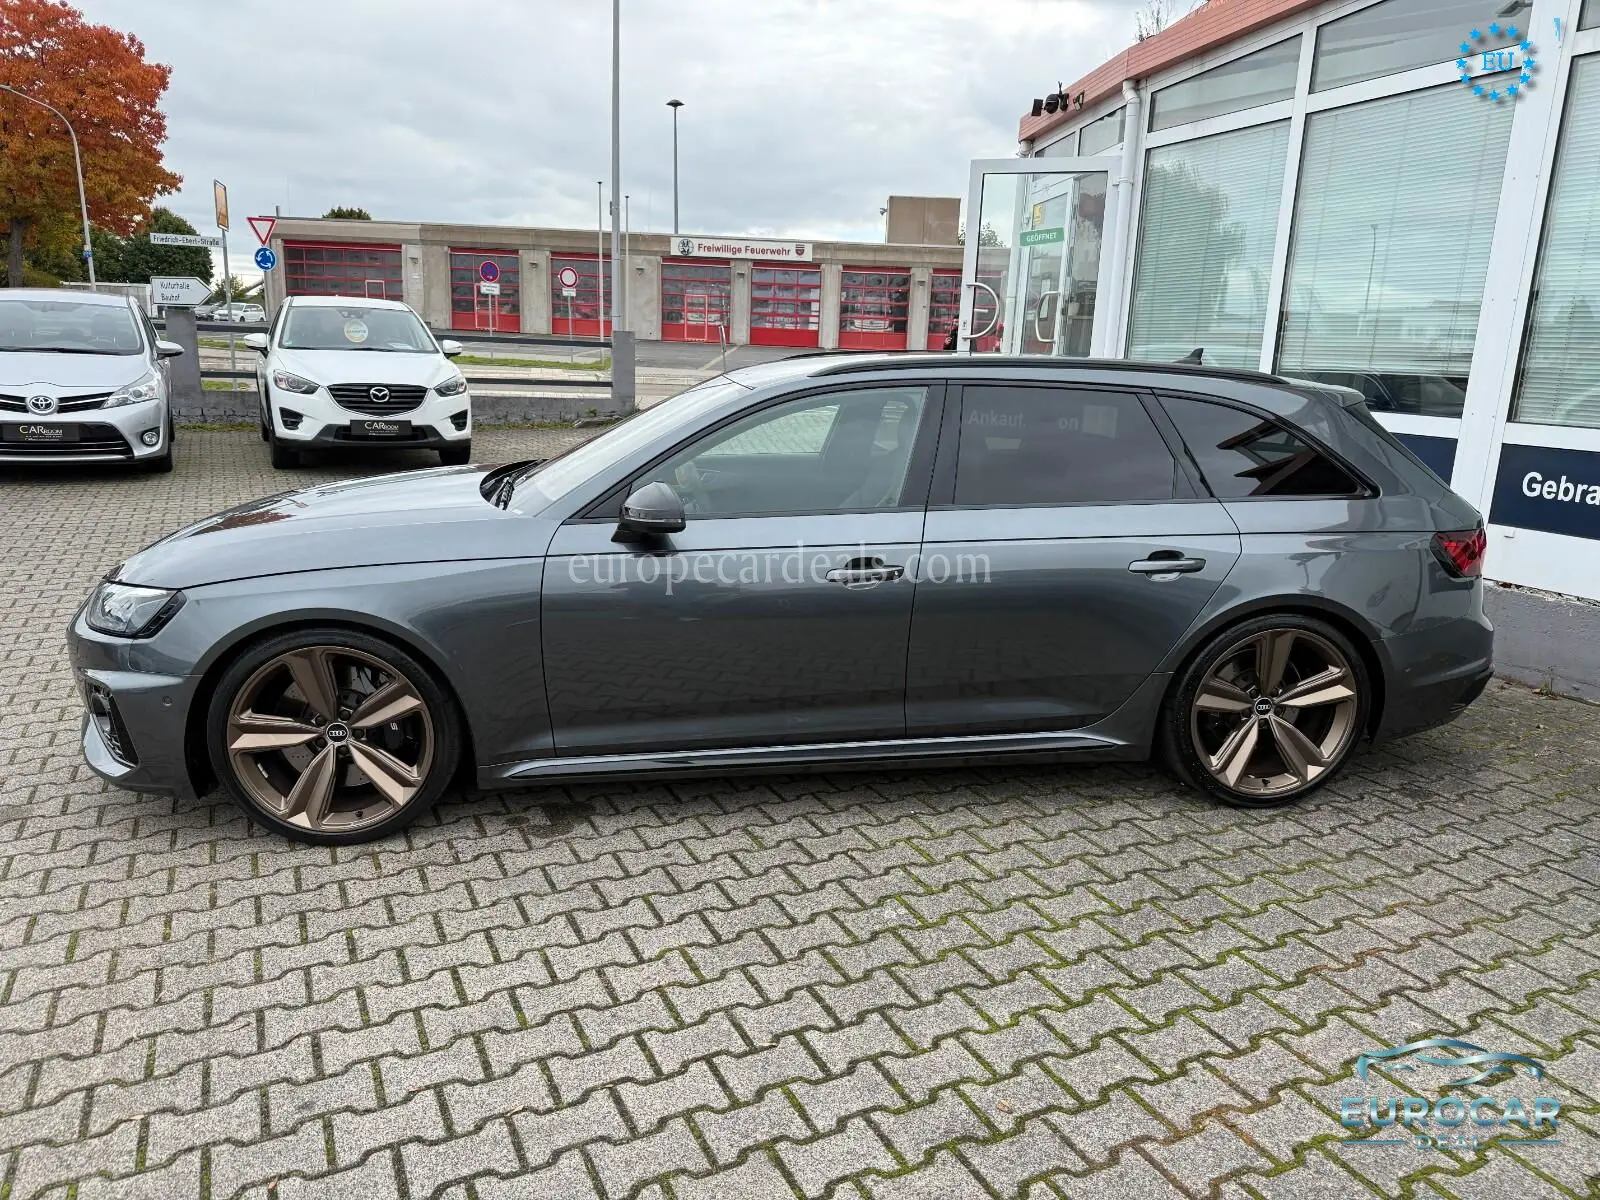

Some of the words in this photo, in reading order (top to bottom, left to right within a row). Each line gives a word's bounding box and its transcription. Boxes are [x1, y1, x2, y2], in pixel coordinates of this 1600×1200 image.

[1026, 232, 1057, 242] GEÖFFNET
[697, 243, 742, 255] Freiwillige
[745, 245, 791, 256] Feuerwehr
